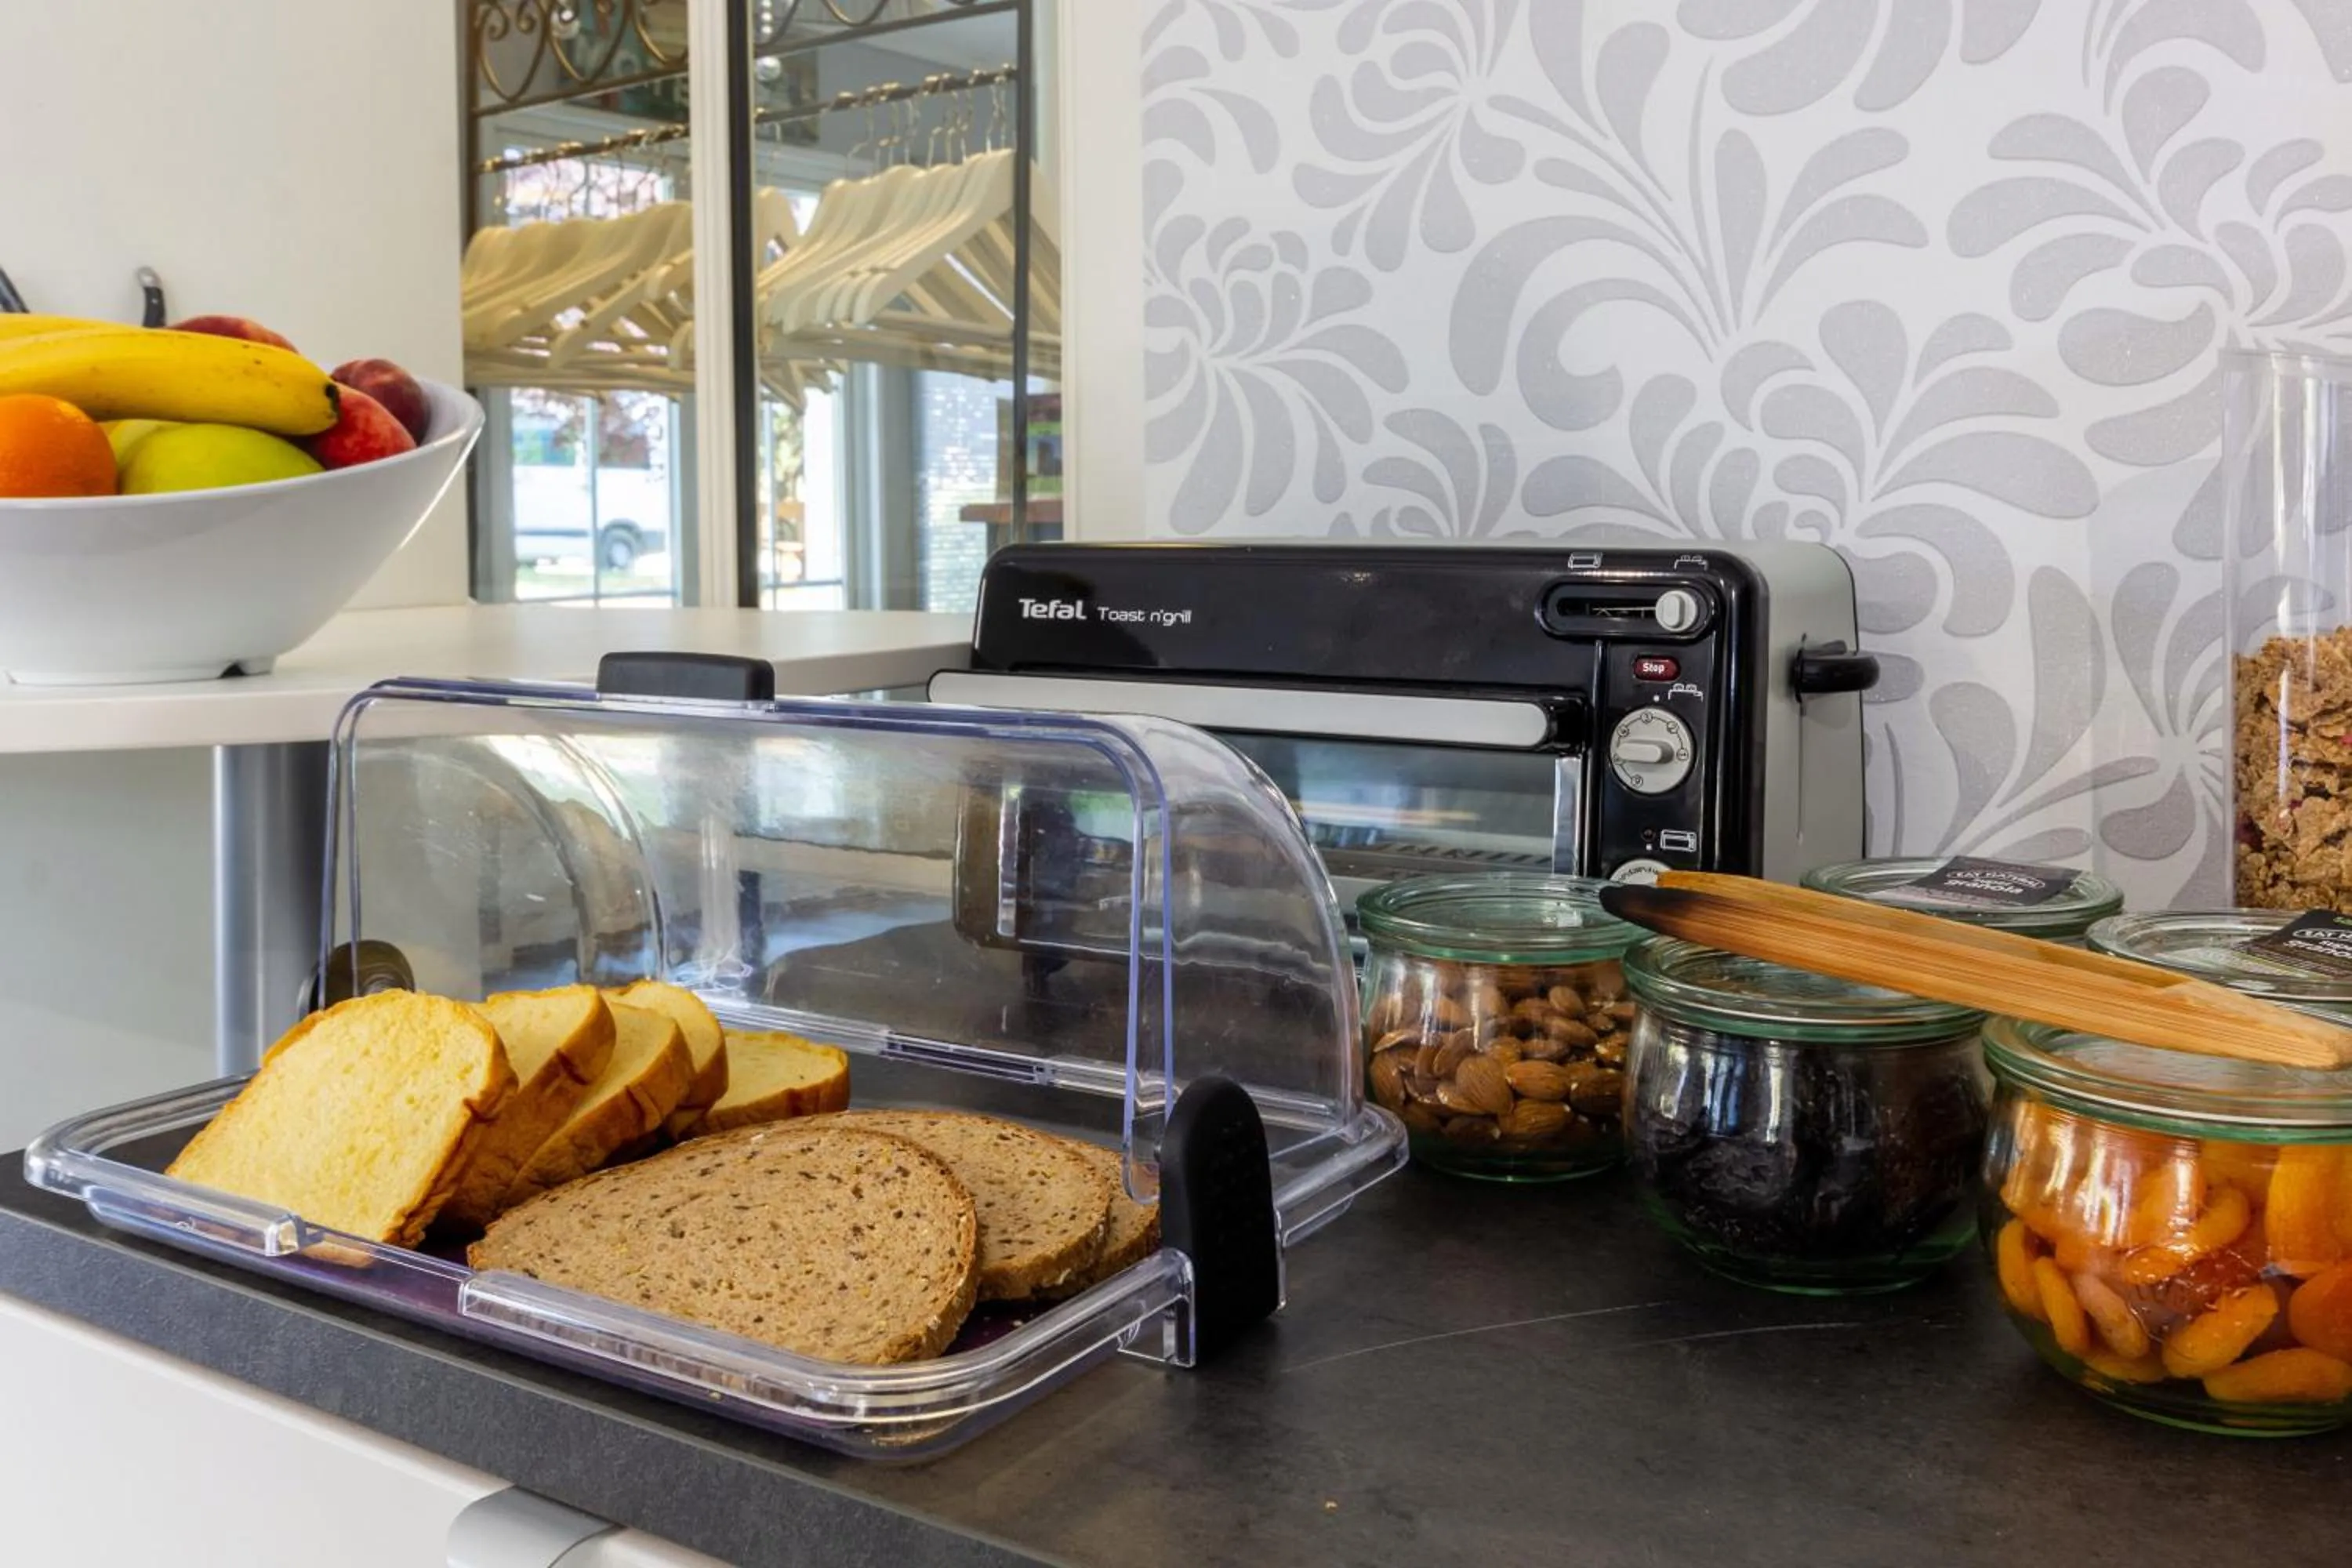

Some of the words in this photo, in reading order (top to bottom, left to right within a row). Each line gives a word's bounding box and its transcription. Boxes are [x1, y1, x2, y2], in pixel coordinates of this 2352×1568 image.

[1018, 598, 1087, 620] Tefal
[1098, 606, 1145, 622] Toast
[1642, 662, 1664, 674] Stop
[2283, 940, 2352, 960] grano
